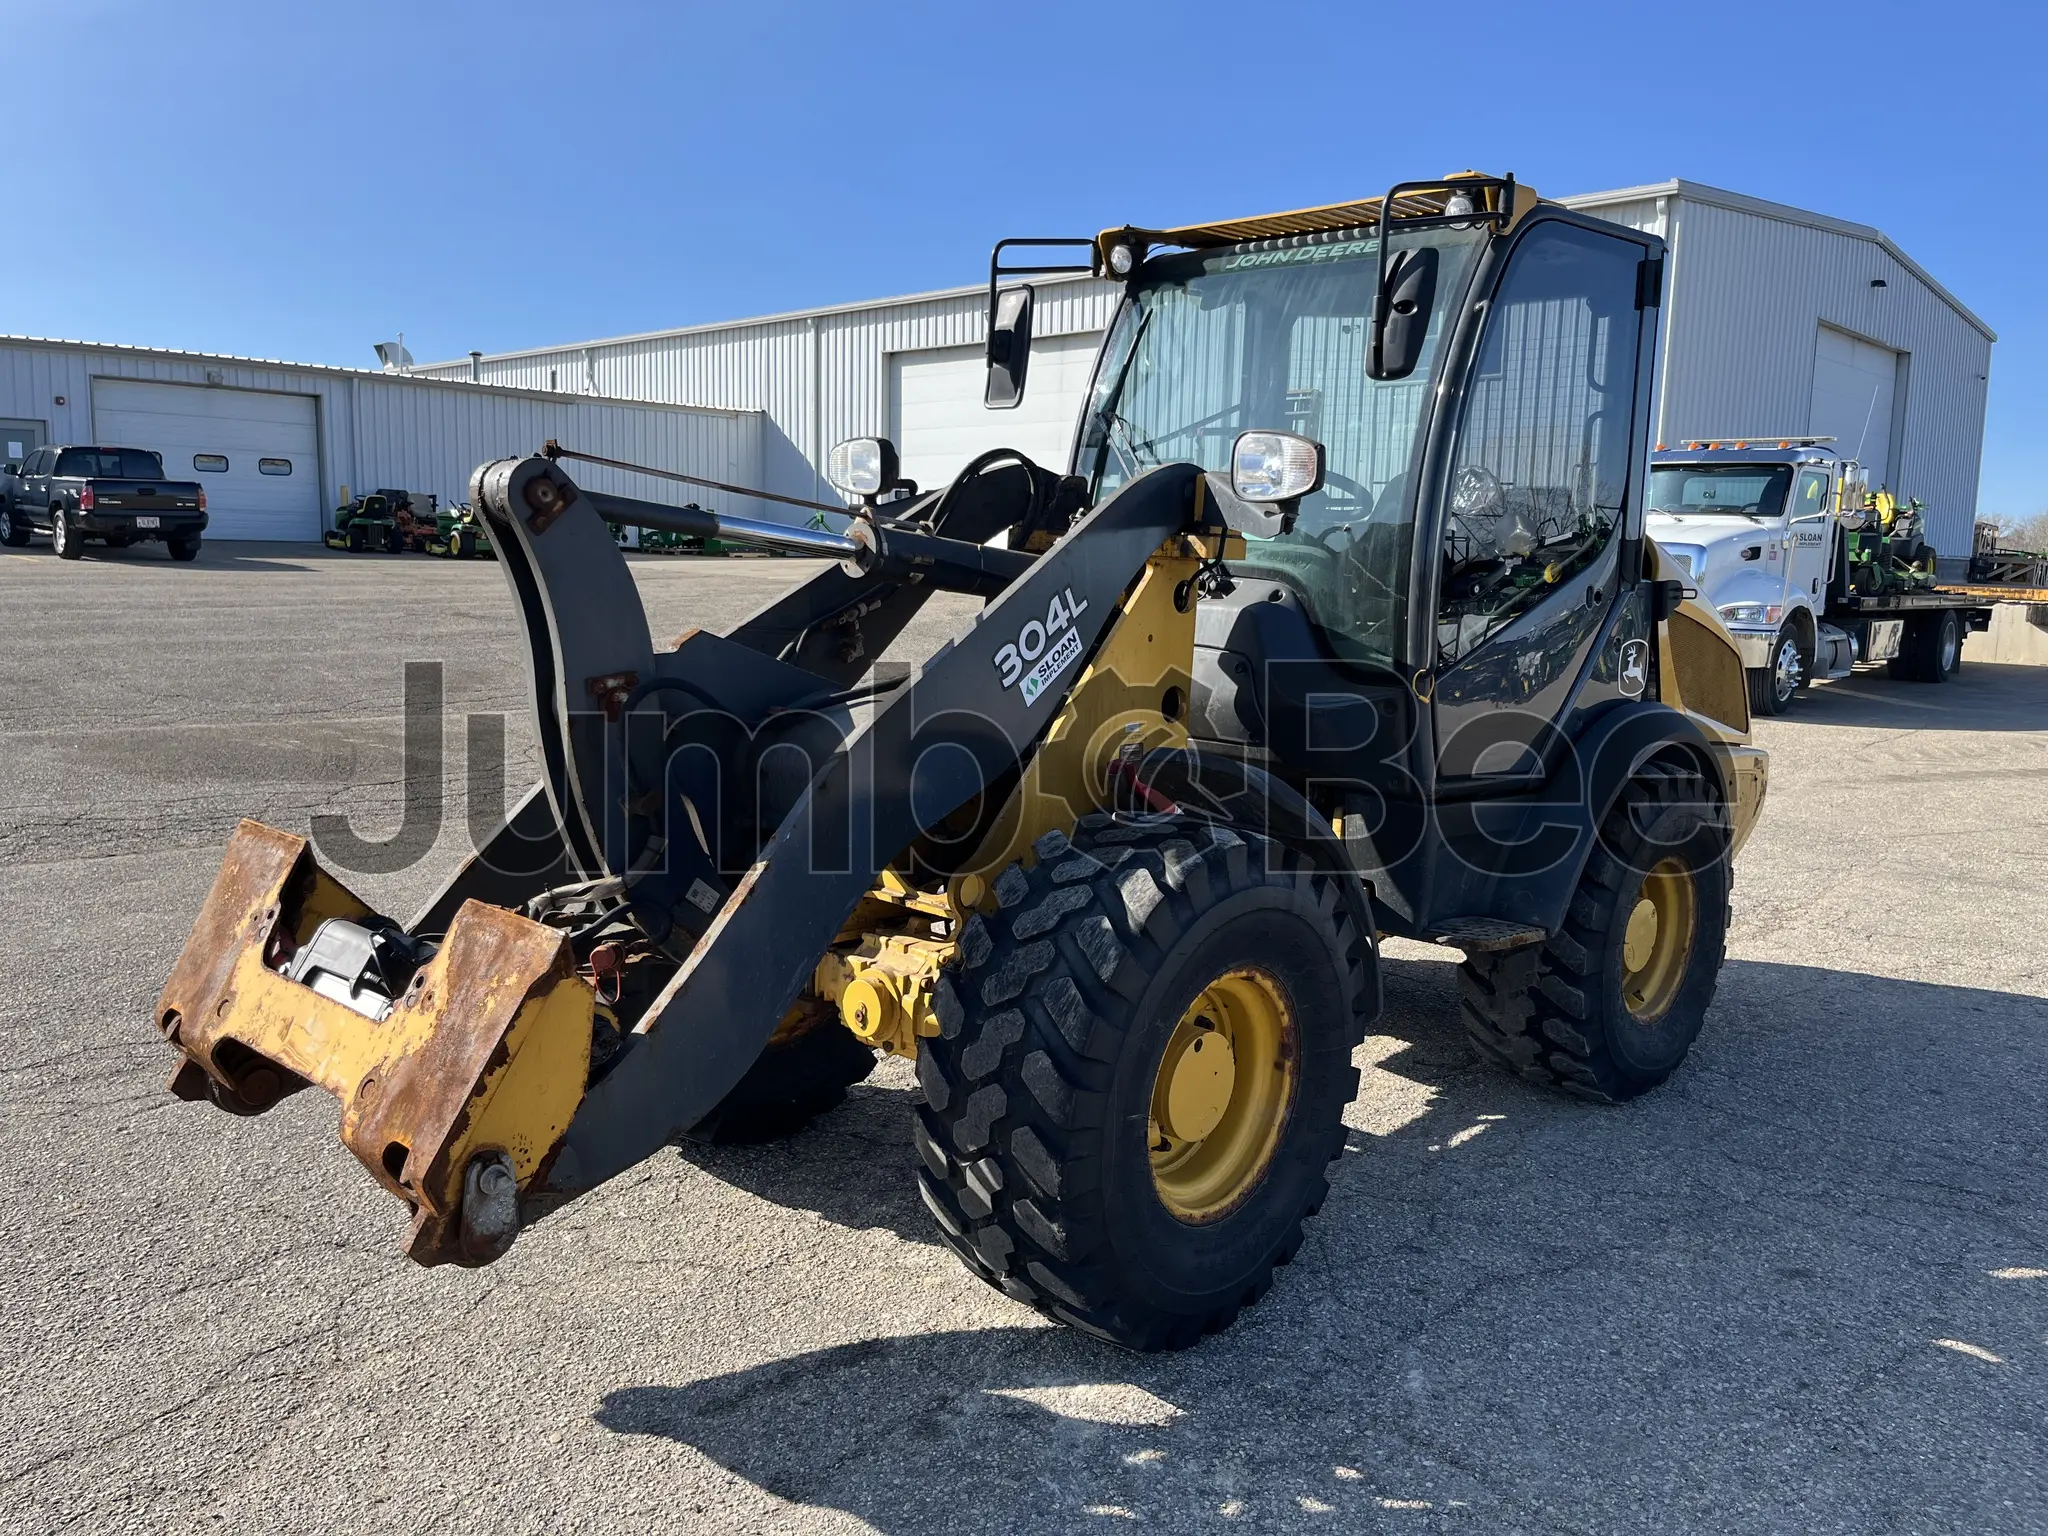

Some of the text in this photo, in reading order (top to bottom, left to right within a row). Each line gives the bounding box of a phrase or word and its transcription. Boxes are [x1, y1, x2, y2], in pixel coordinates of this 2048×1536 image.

[1225, 240, 1380, 269] JOHN DEERE
[1799, 533, 1823, 542] SLOAN
[993, 587, 1089, 688] 304L
[1037, 632, 1078, 679] SLOAN
[1041, 642, 1080, 686] IMPLEMENT
